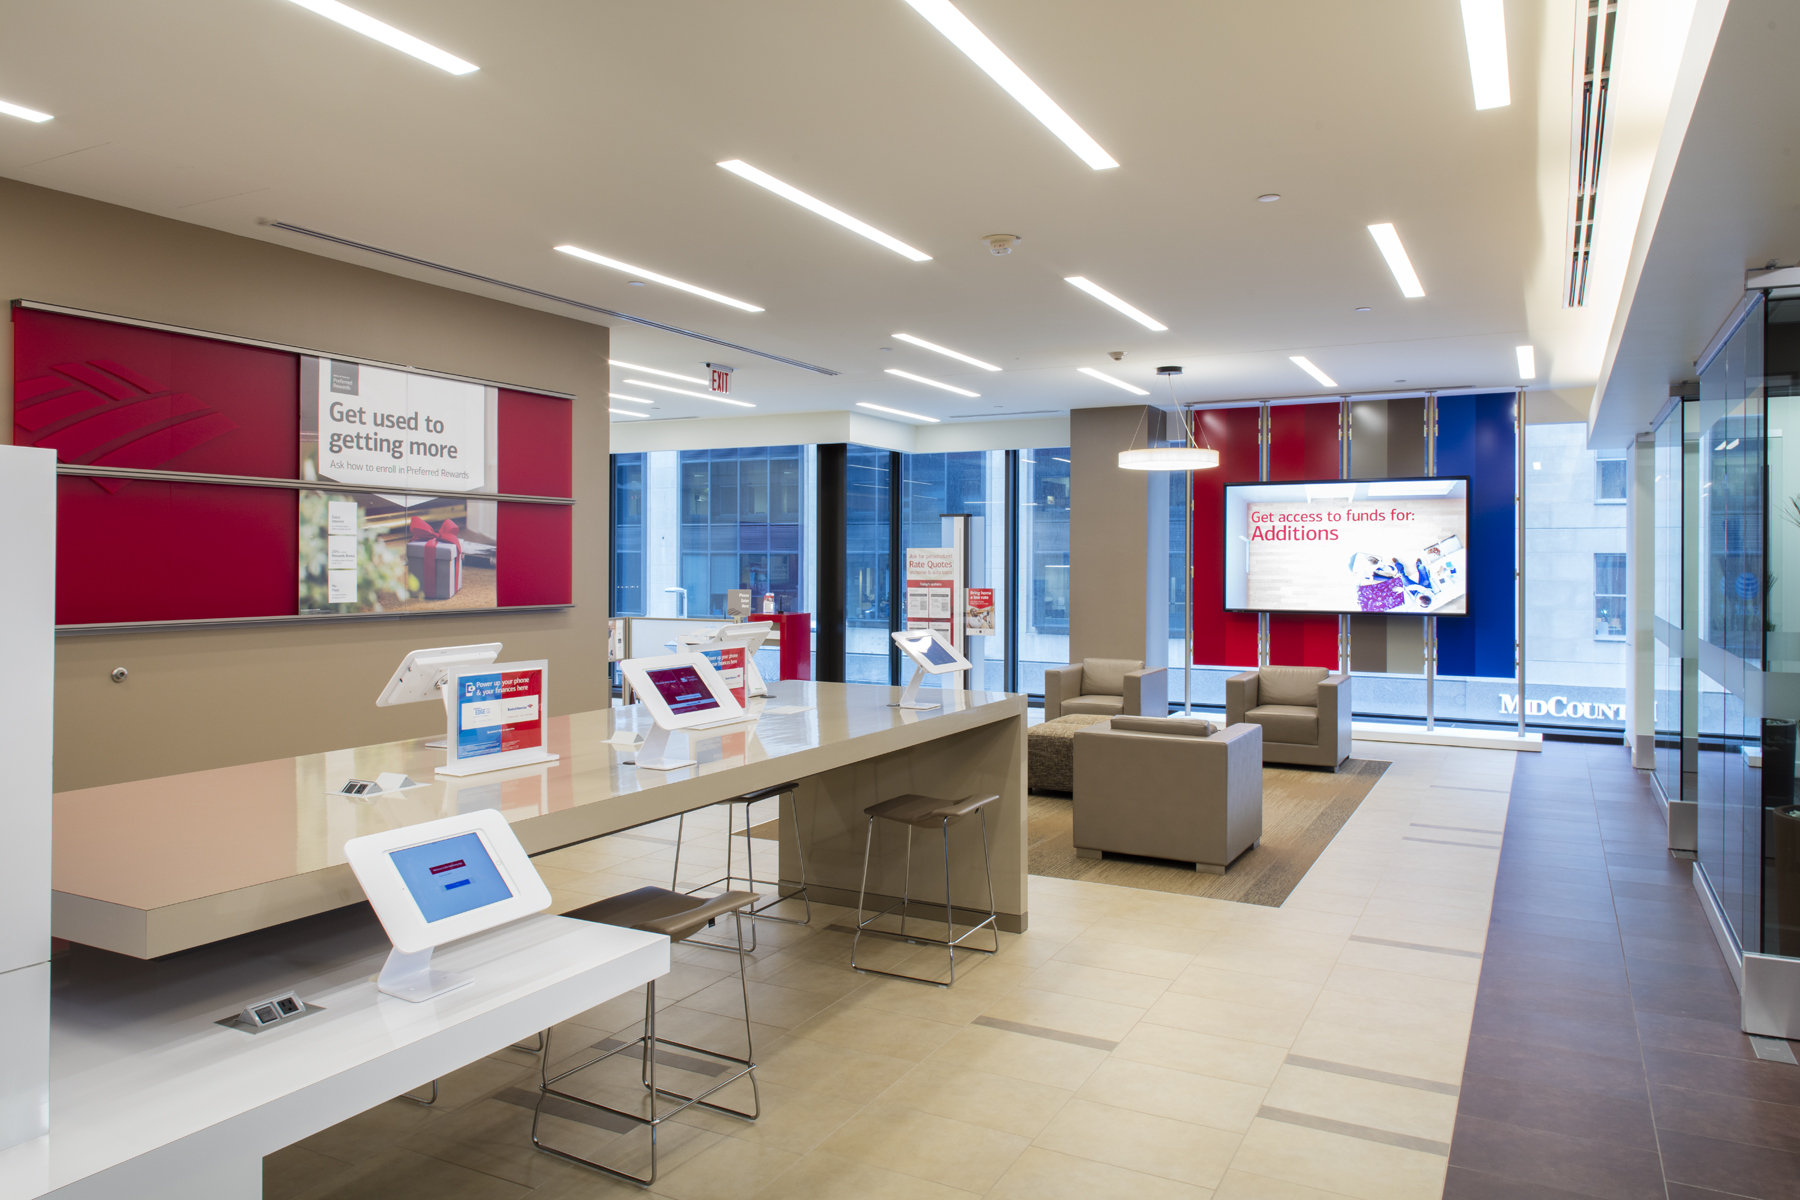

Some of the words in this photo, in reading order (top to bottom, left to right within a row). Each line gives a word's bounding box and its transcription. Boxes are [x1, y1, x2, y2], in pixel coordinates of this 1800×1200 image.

[712, 370, 728, 394] EXIT
[330, 401, 366, 425] Get
[373, 411, 418, 431] used
[425, 415, 444, 434] to
[329, 432, 404, 459] getting
[410, 440, 458, 459] more
[330, 459, 344, 469] Ask
[346, 461, 364, 471] how
[365, 463, 374, 472] to
[376, 465, 396, 473] enroll
[398, 466, 405, 474] in
[406, 466, 439, 476] Preferred
[441, 469, 469, 479] Rewards
[1251, 511, 1274, 523] Get
[1278, 512, 1322, 522] access
[1327, 511, 1342, 521] to
[1346, 509, 1385, 521] funds
[1390, 509, 1415, 521] for:
[1251, 525, 1338, 541] Additions
[927, 561, 952, 569] Quotes
